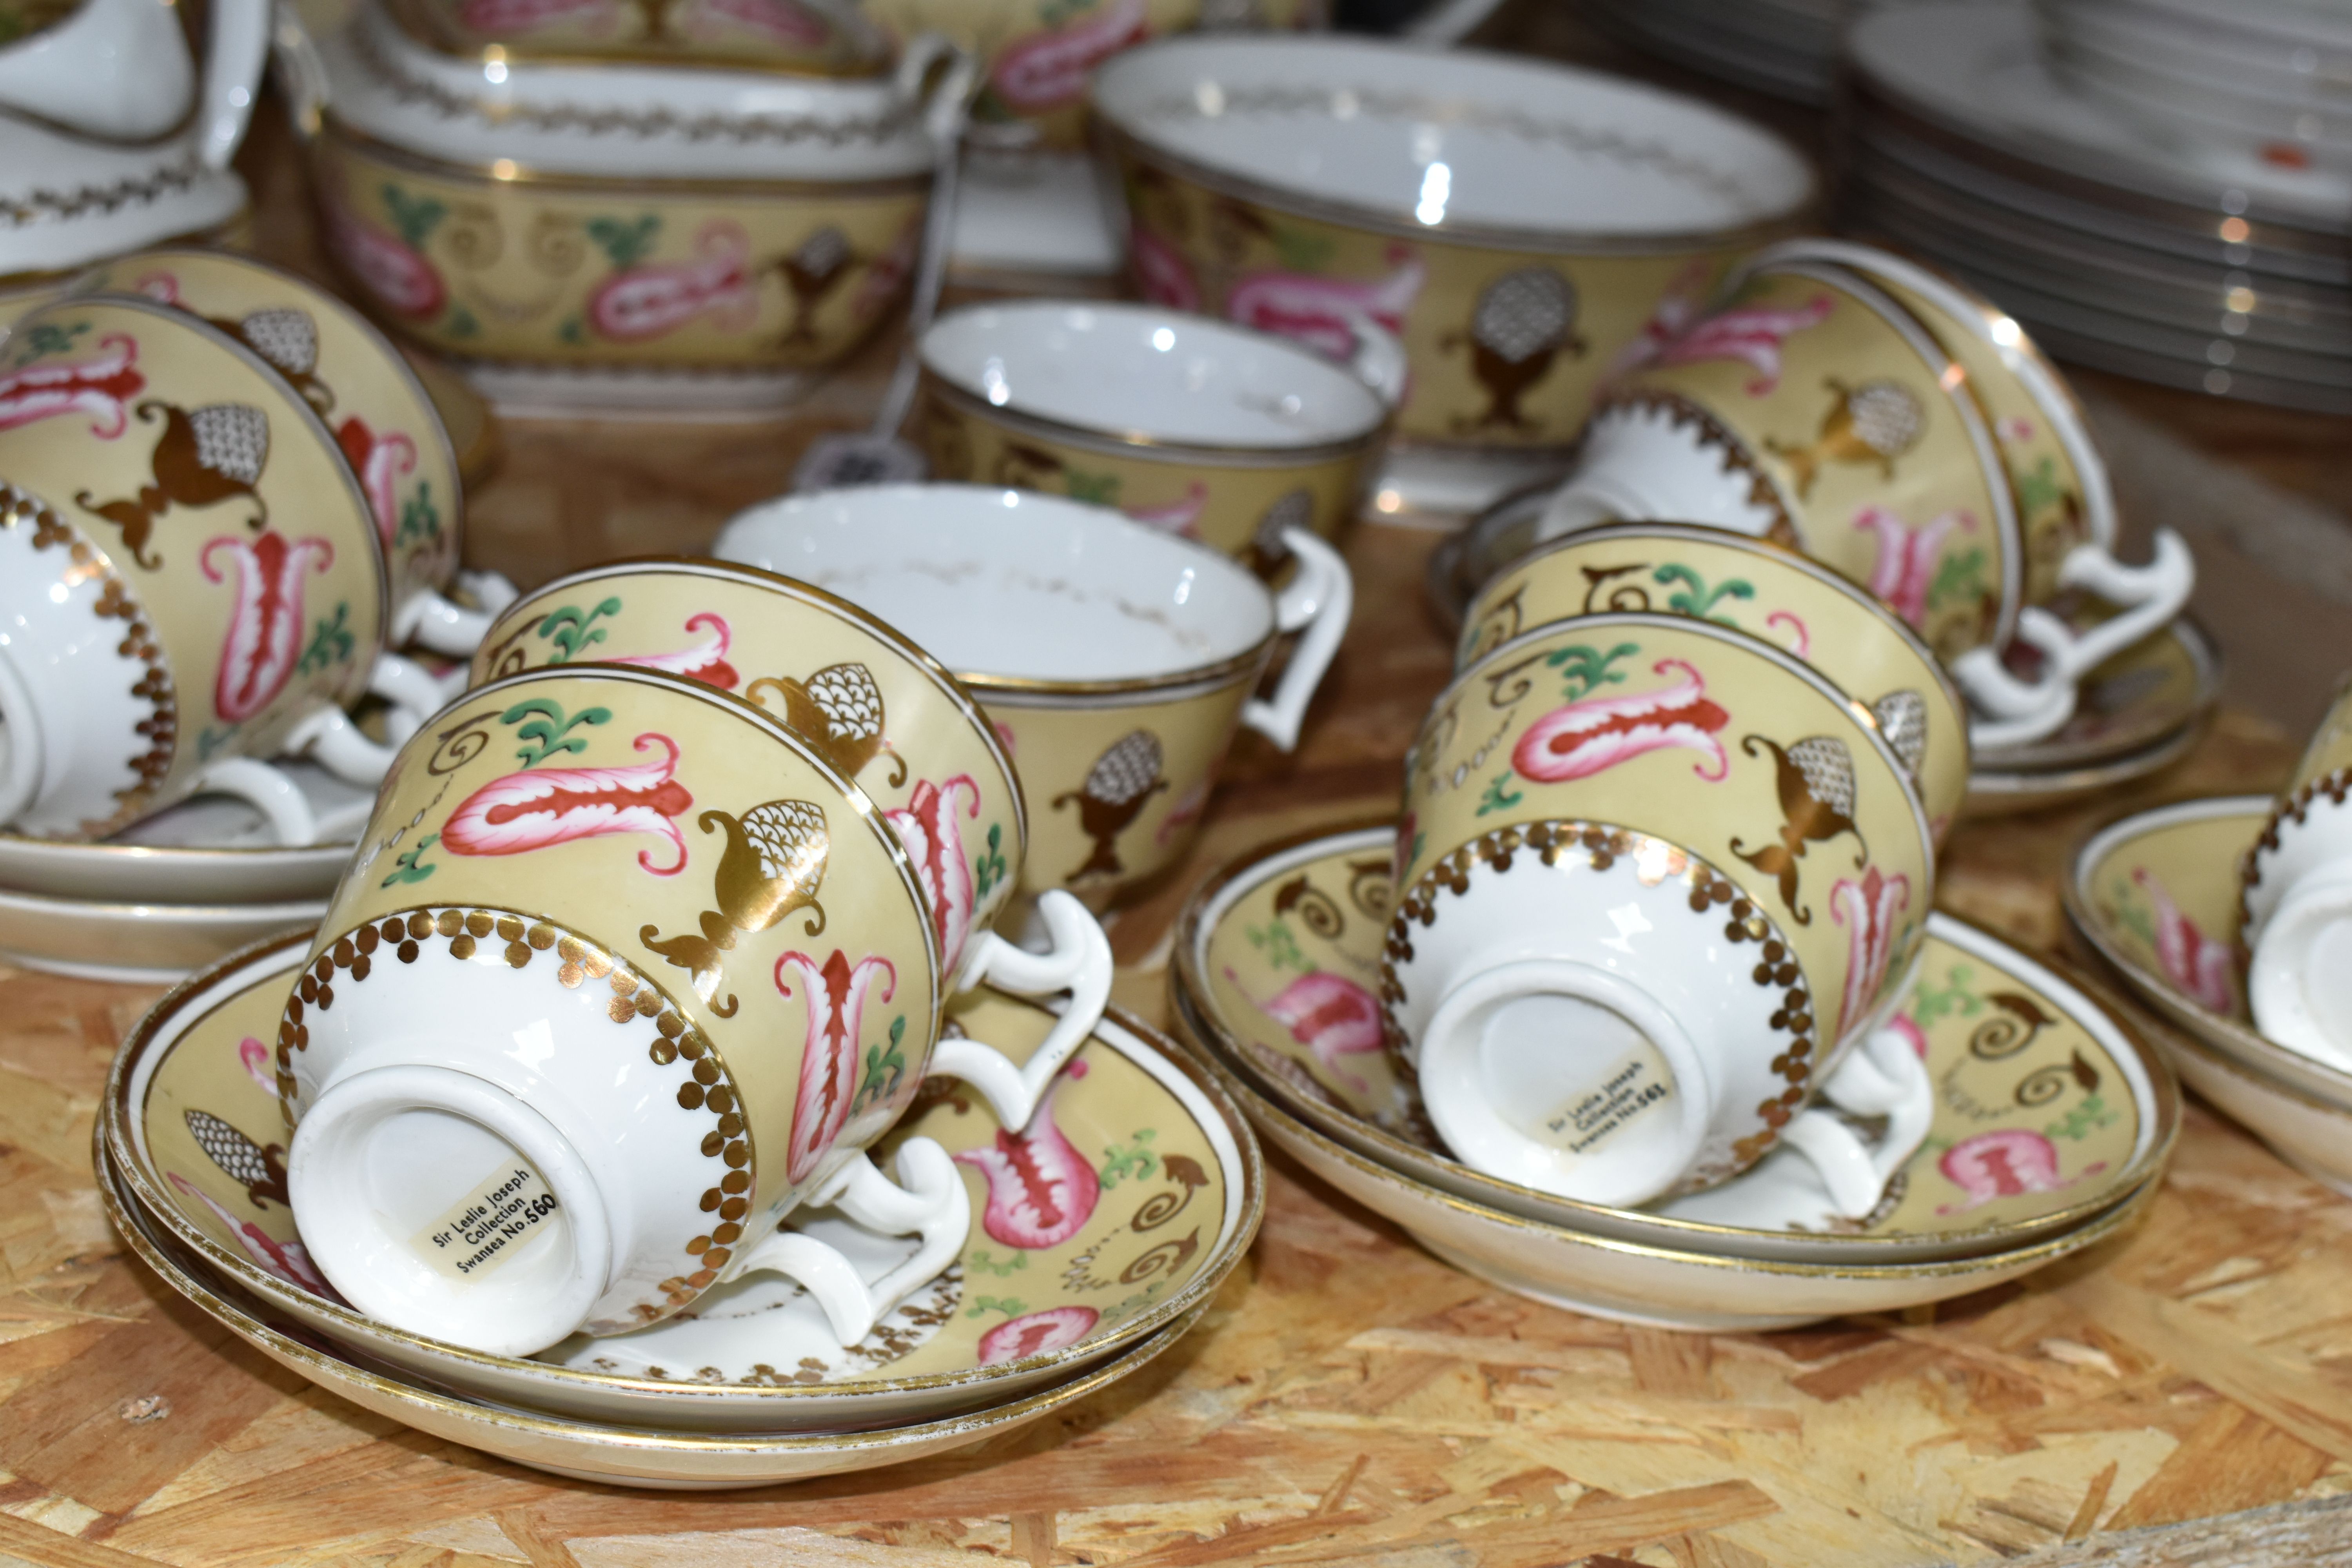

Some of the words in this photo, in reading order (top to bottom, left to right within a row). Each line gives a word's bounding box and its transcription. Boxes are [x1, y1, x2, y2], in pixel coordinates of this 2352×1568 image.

[1567, 1094, 1602, 1118] Leslie
[1602, 1062, 1643, 1096] Joseph
[1575, 1088, 1633, 1131] Collection
[1569, 1120, 1618, 1153] Swansea
[432, 1231, 452, 1247] Sir
[450, 1205, 487, 1234] Leslie
[485, 1169, 530, 1209] Joseph
[465, 1198, 526, 1245] Collection
[457, 1237, 506, 1273] Swansea
